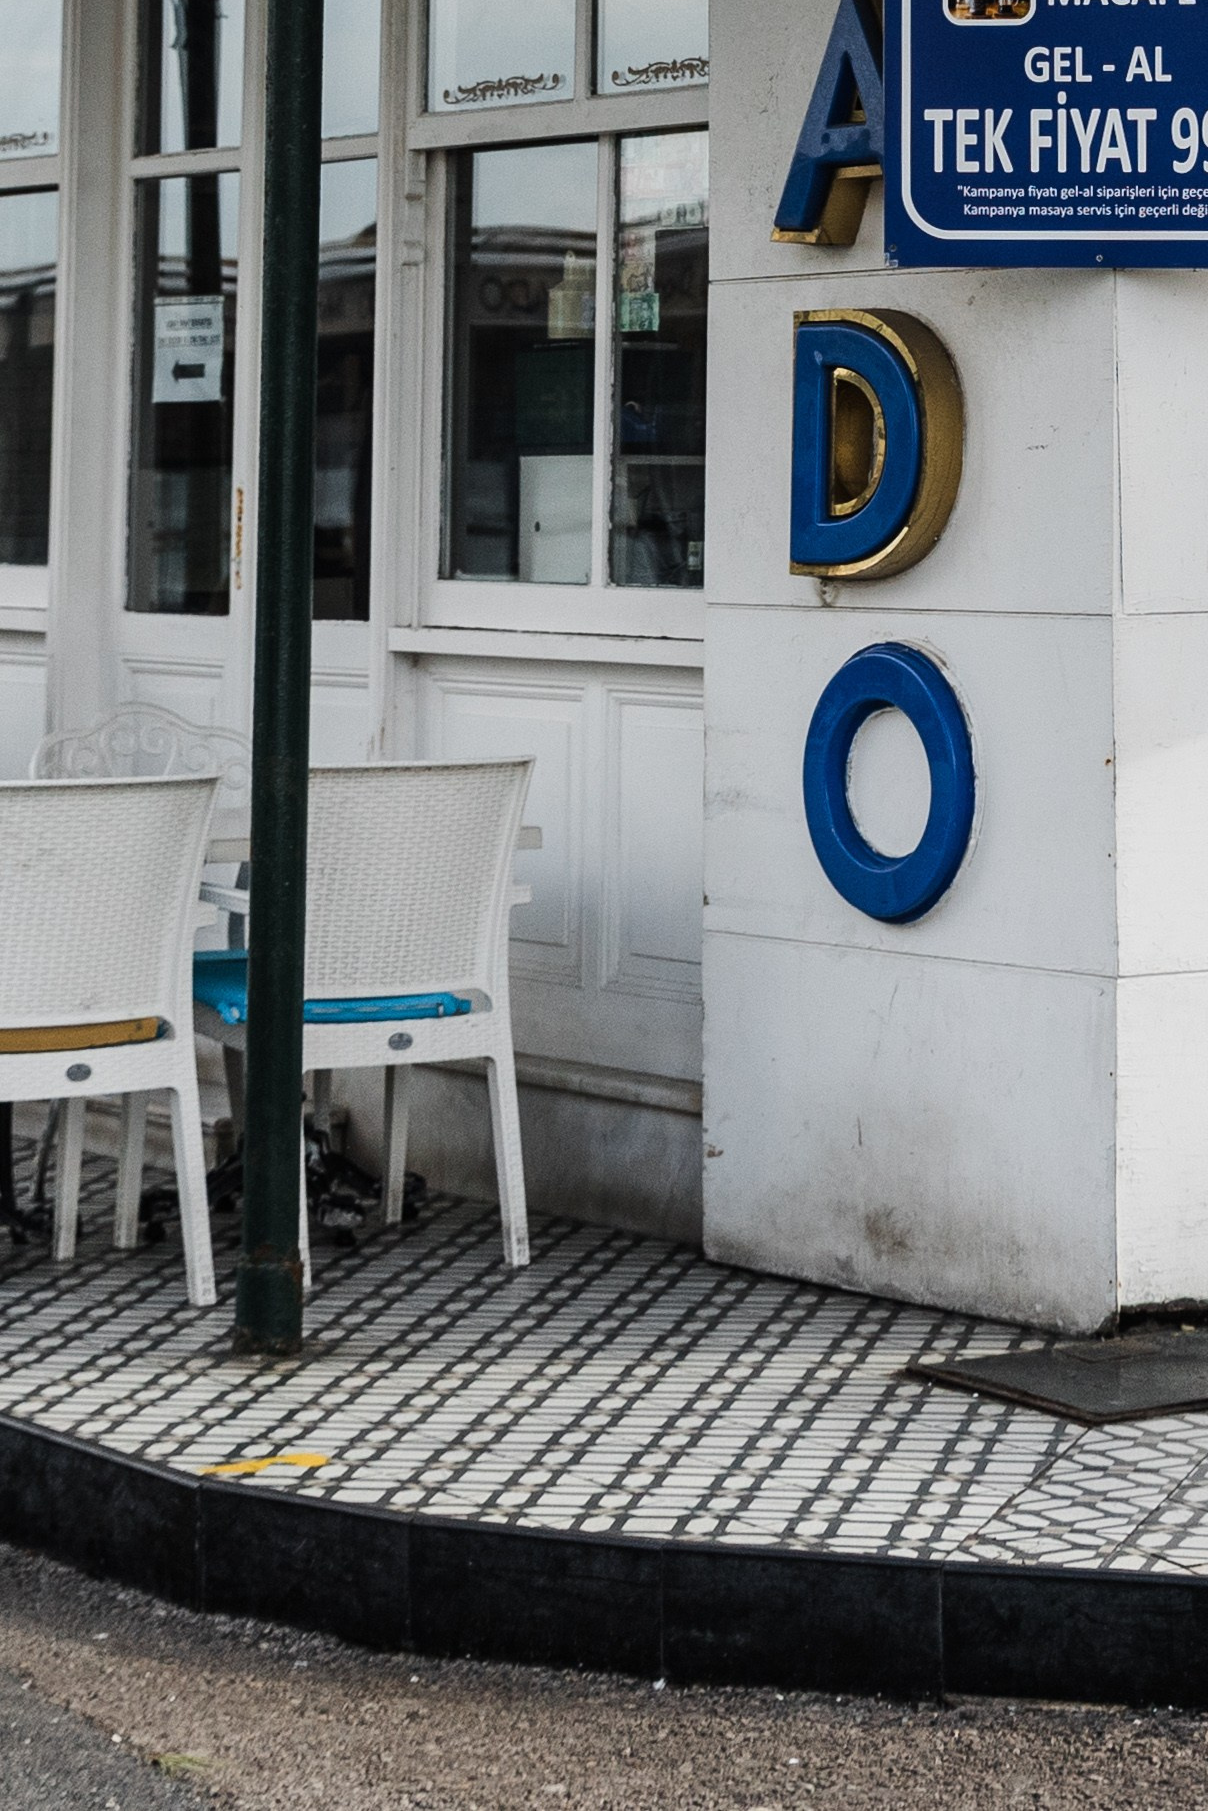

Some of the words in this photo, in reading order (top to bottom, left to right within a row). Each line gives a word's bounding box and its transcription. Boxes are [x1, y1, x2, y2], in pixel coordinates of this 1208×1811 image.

[1024, 46, 1092, 83] GEL
[1126, 46, 1172, 83] AL
[924, 108, 1013, 174] TEK
[1030, 91, 1157, 174] FİYAT
[1060, 185, 1094, 200] gel-al
[1096, 185, 1155, 200] siparişleri
[1158, 185, 1179, 200] için
[963, 204, 1026, 218] Kampanya
[1028, 206, 1073, 218] masaya
[1077, 204, 1112, 216] servis
[1114, 204, 1136, 218] için
[1138, 204, 1179, 218] geçerli
